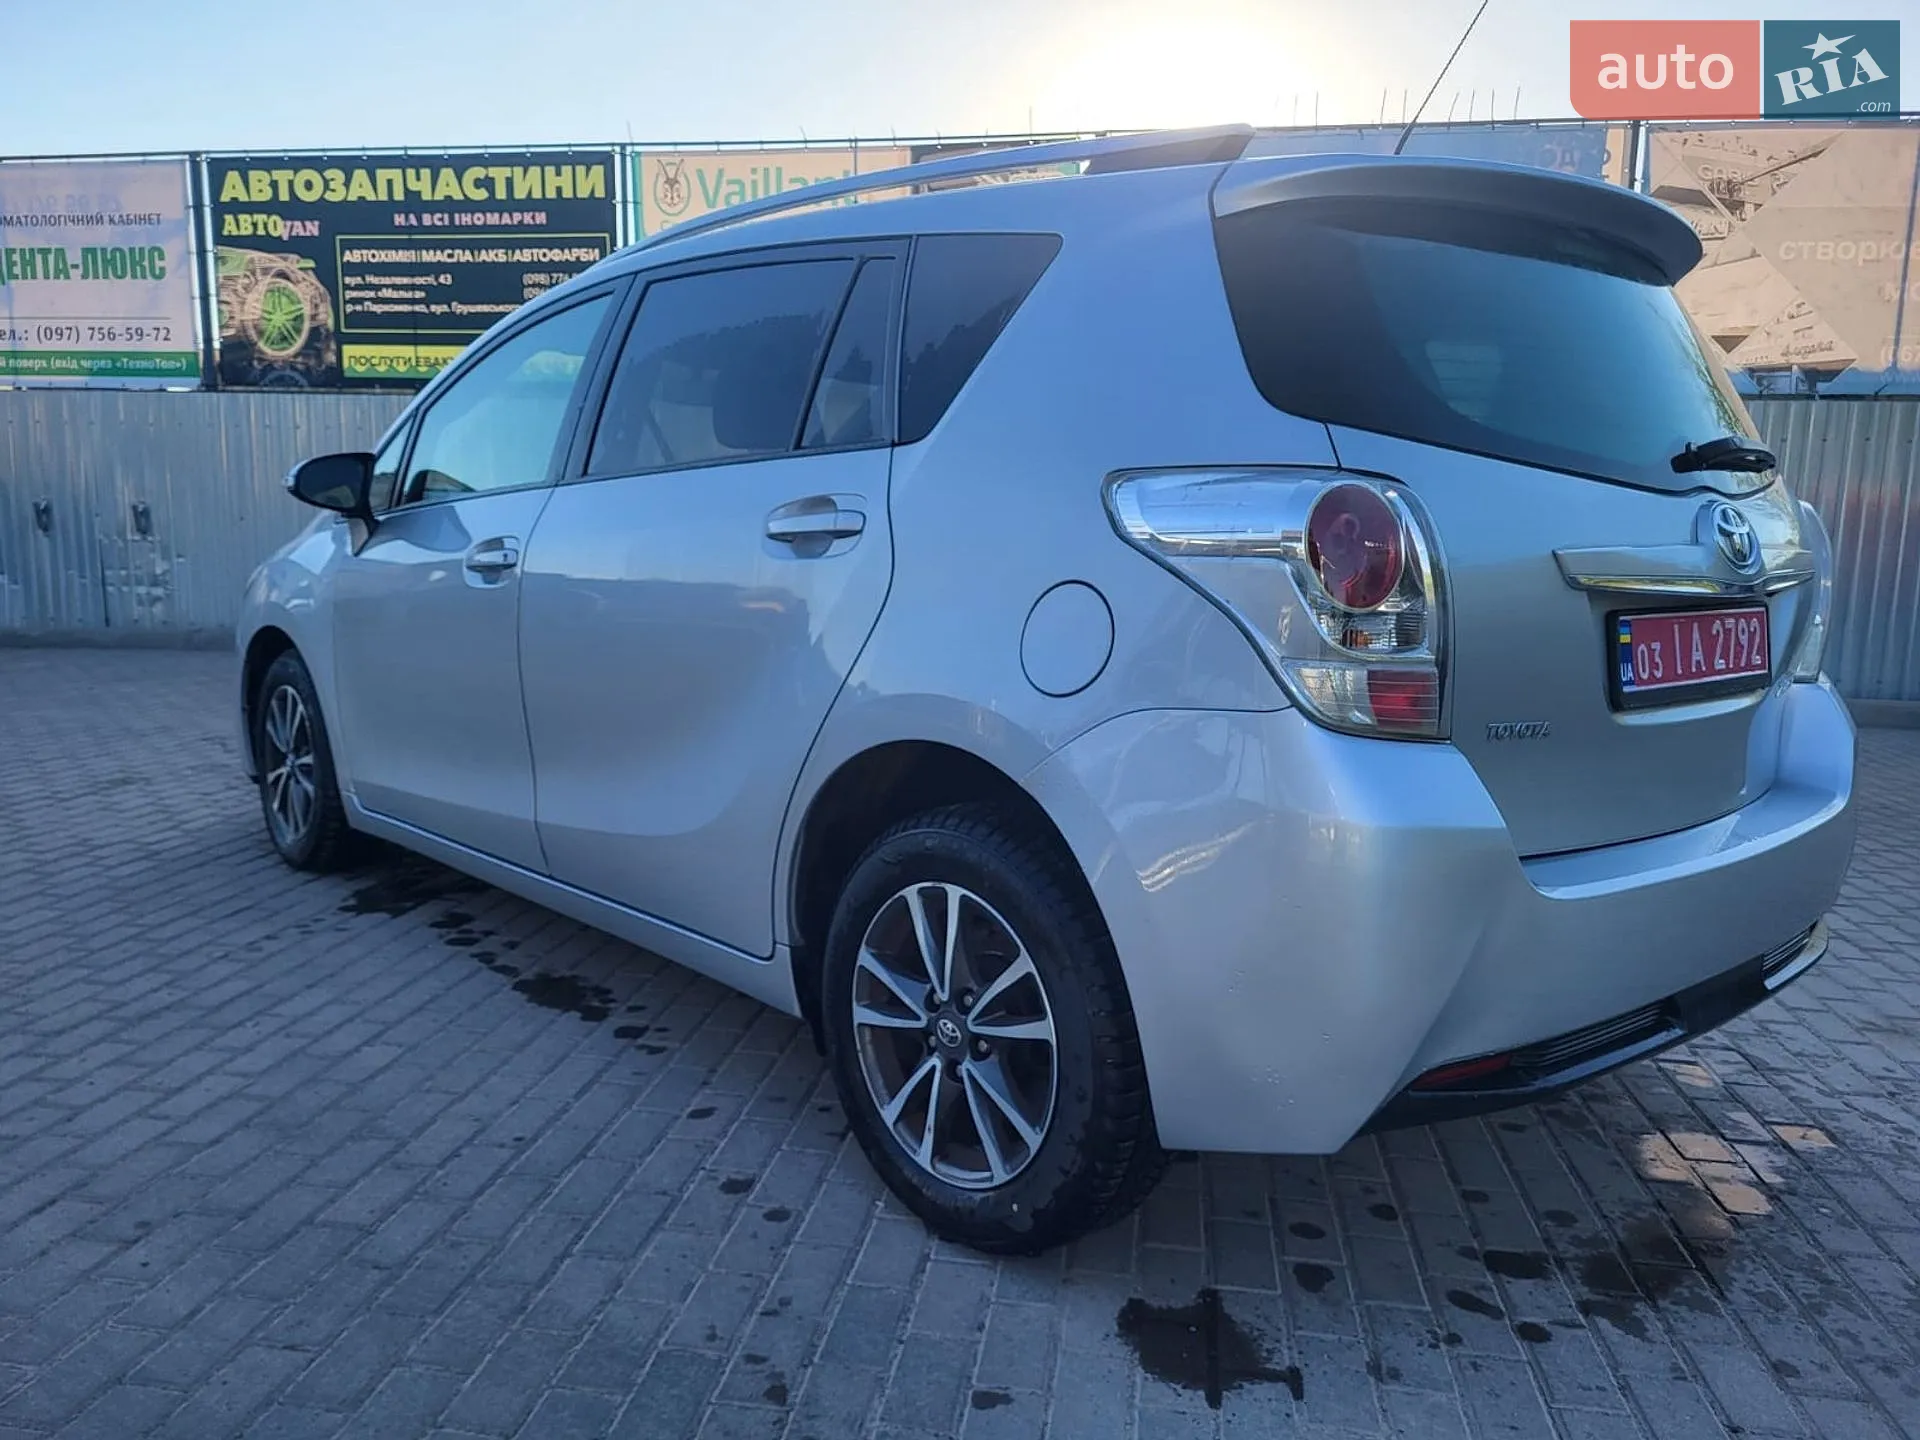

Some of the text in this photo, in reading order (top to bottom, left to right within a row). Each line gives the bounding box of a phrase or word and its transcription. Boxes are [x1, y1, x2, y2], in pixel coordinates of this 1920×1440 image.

[219, 164, 605, 202] АВТОЗАПЧАСТИНИ
[0, 211, 161, 228] МАТОЛОГІЧНИЙ КАБІНЕТ
[394, 211, 547, 226] НА ВСІ ІНОМАРКИ
[343, 248, 600, 263] АВТОХІМІЯ МАСЛА АКБ АВТОФАРБИ
[36, 325, 80, 344] (097)
[88, 326, 172, 342] 756-59-72
[1637, 642, 1663, 680] 03
[1711, 617, 1763, 671] 2792
[1620, 662, 1634, 682] UA
[1486, 720, 1551, 742] TOYOTA
